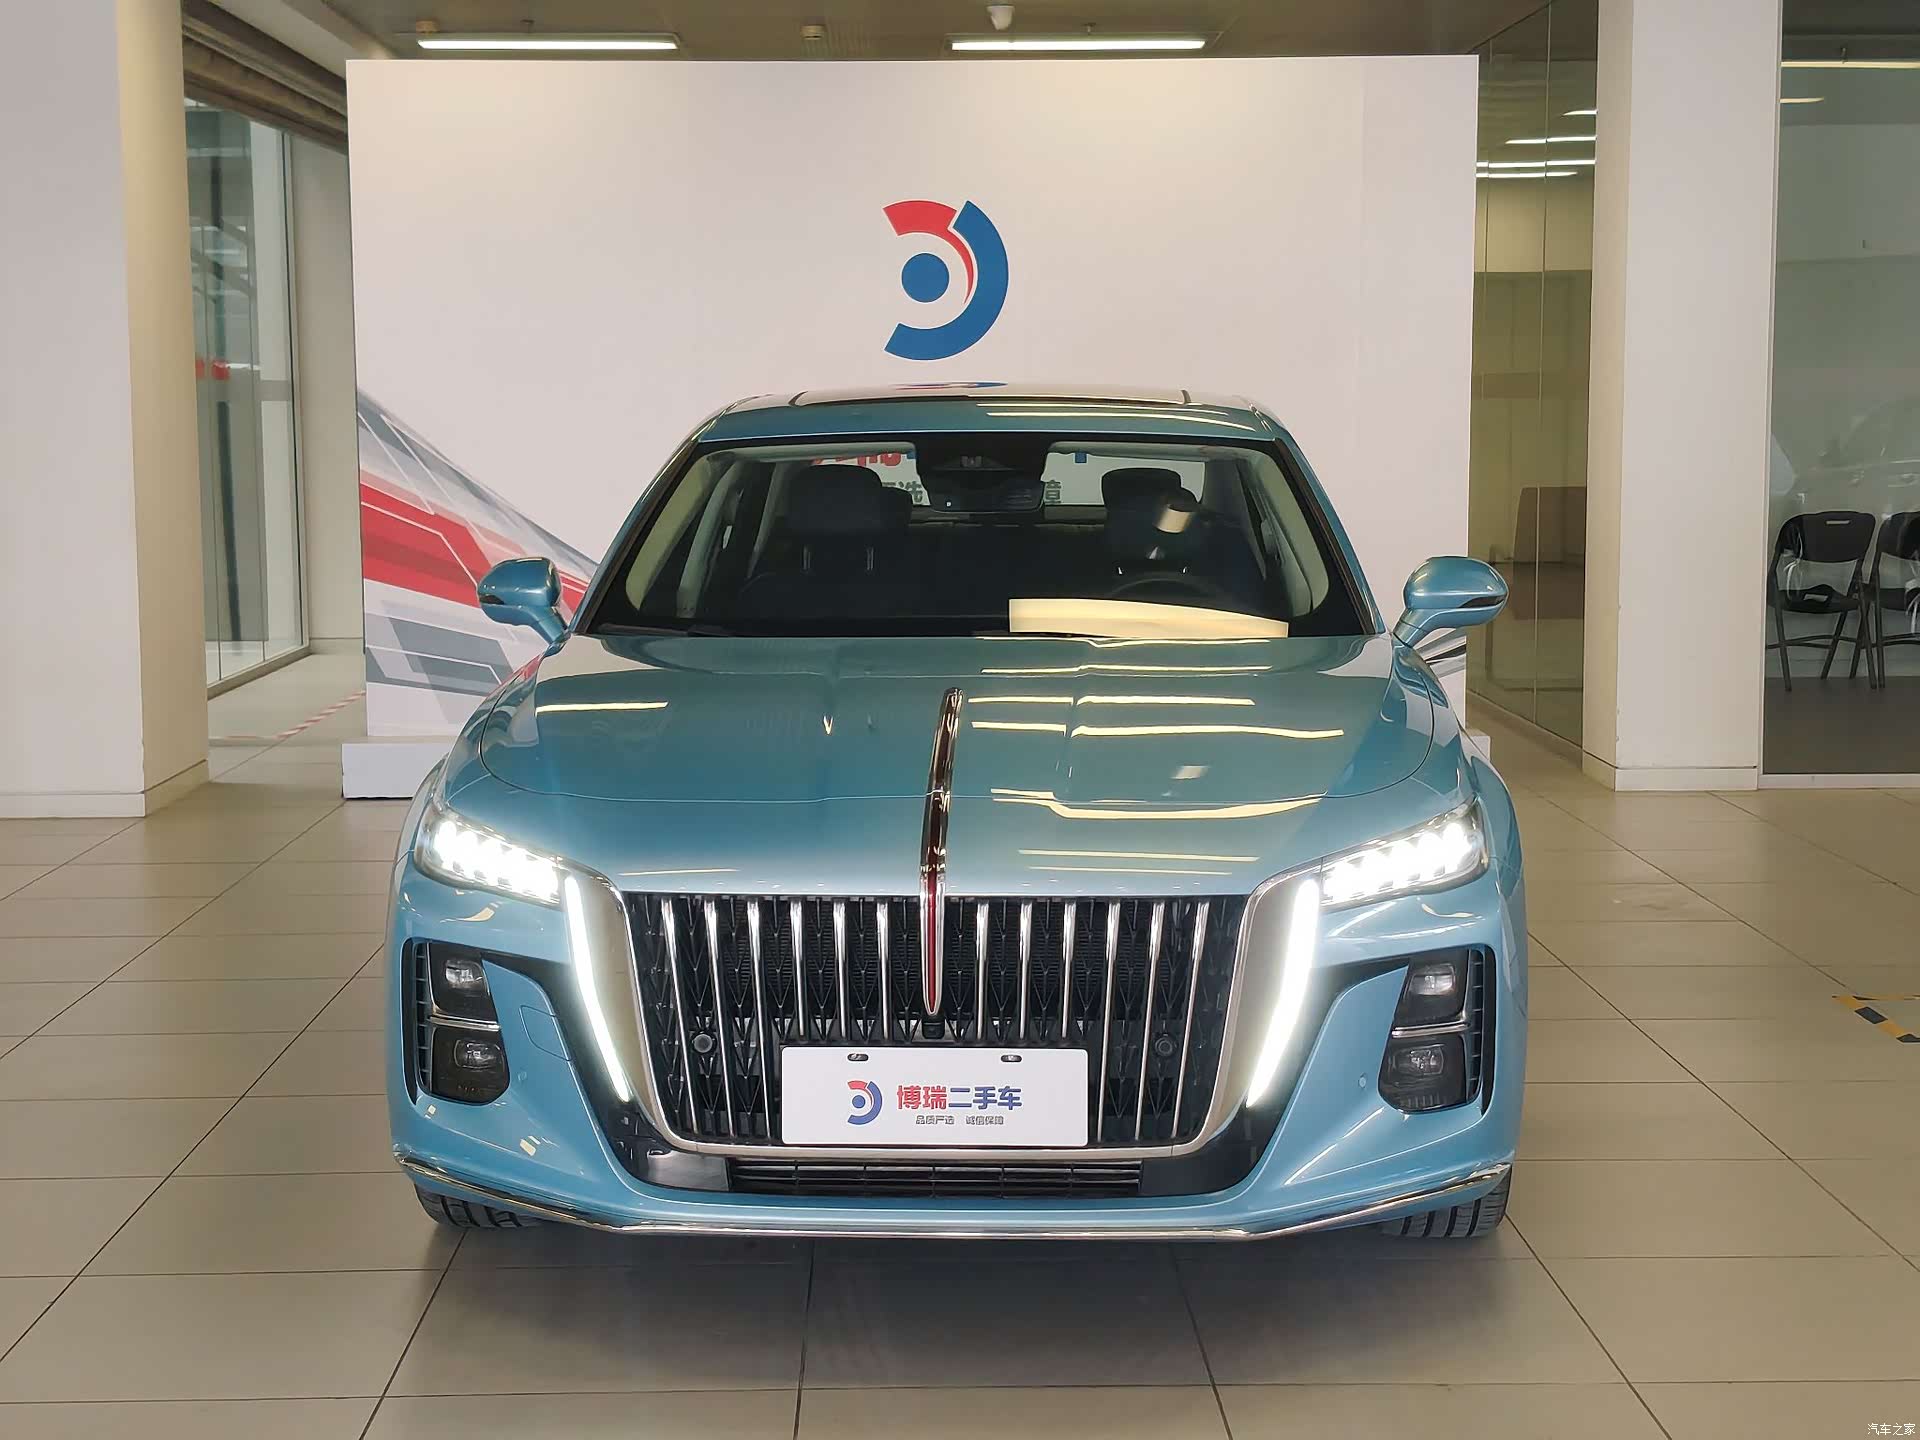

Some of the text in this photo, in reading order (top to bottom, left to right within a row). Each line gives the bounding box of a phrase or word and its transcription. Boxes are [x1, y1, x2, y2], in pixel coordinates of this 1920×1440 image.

[897, 1085, 1022, 1111] 博瑞二手车
